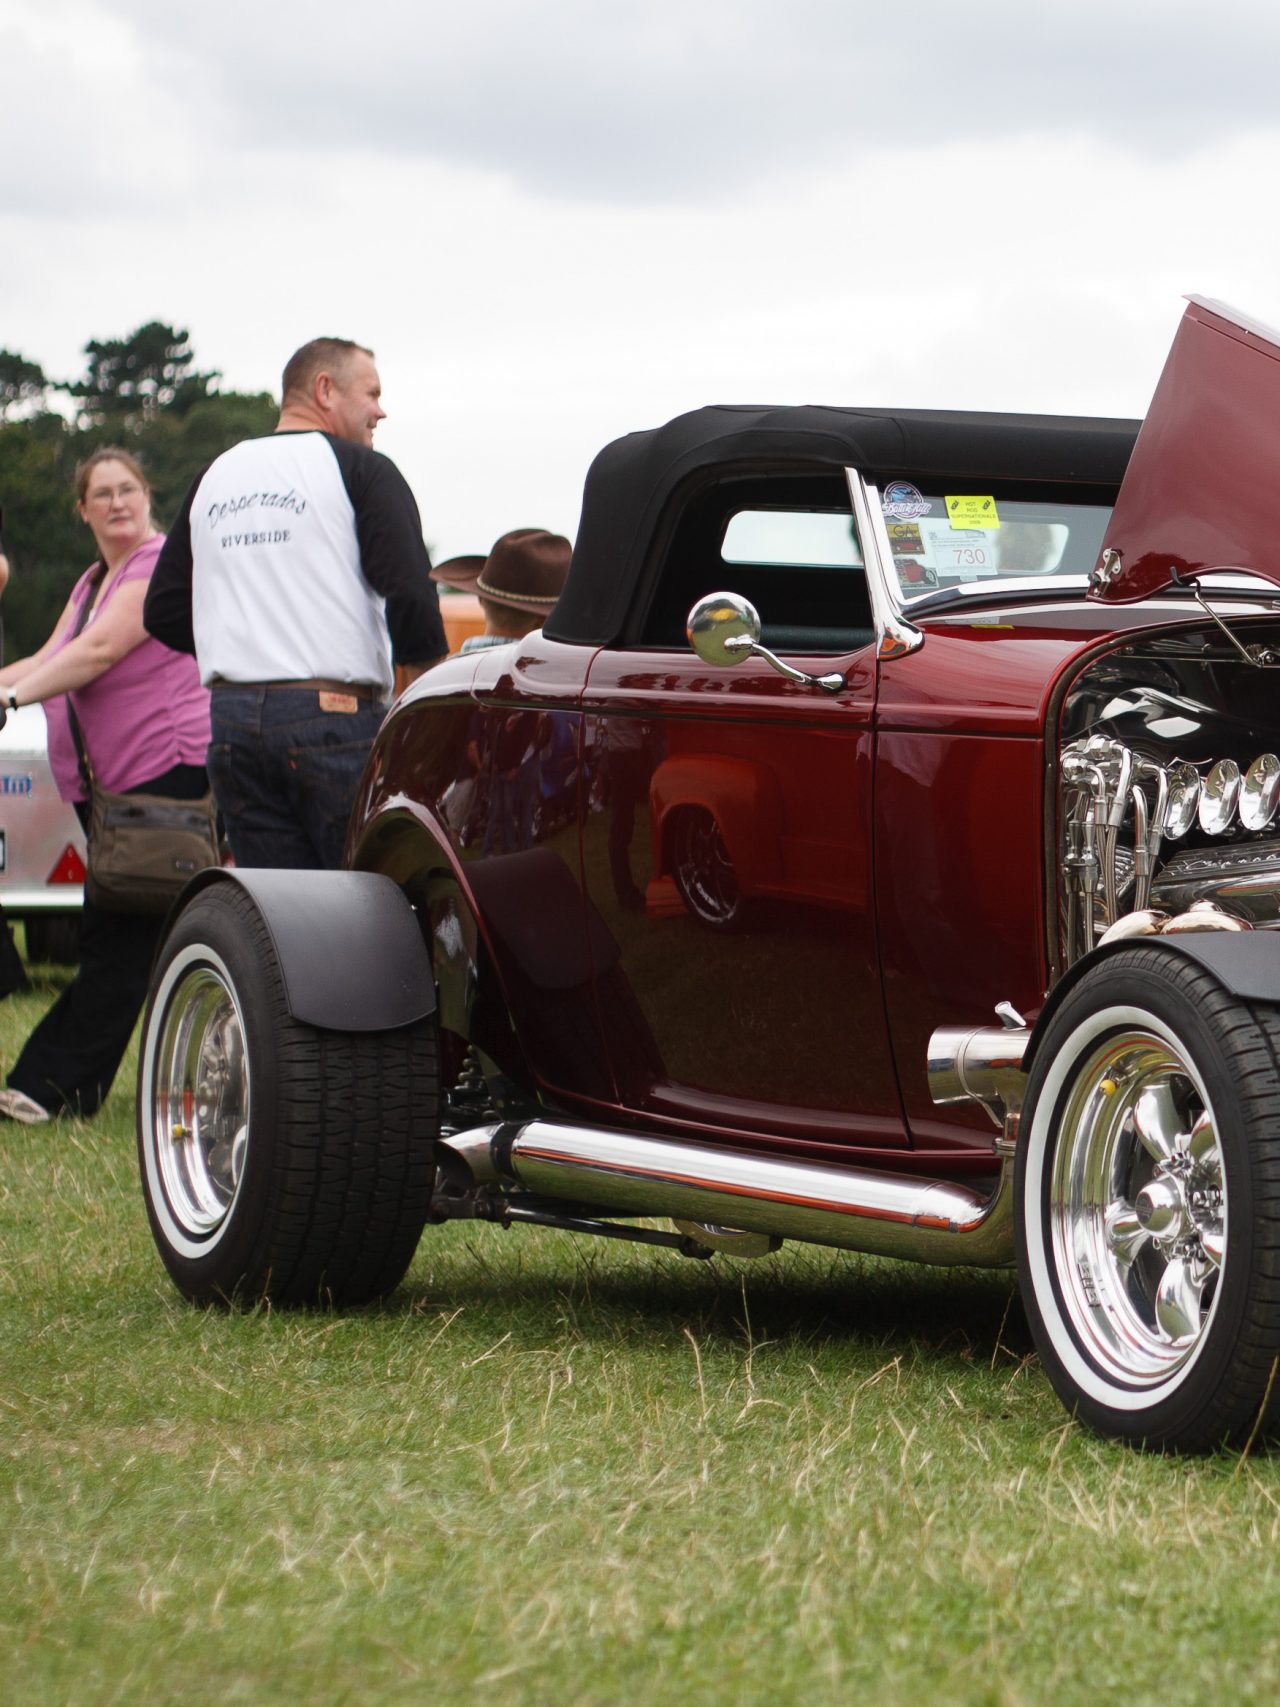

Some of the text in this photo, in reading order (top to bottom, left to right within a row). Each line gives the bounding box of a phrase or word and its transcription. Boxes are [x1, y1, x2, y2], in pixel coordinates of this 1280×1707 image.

[207, 489, 306, 530] Desperados
[221, 530, 291, 549] RIVERSIDE
[952, 548, 986, 565] 730
